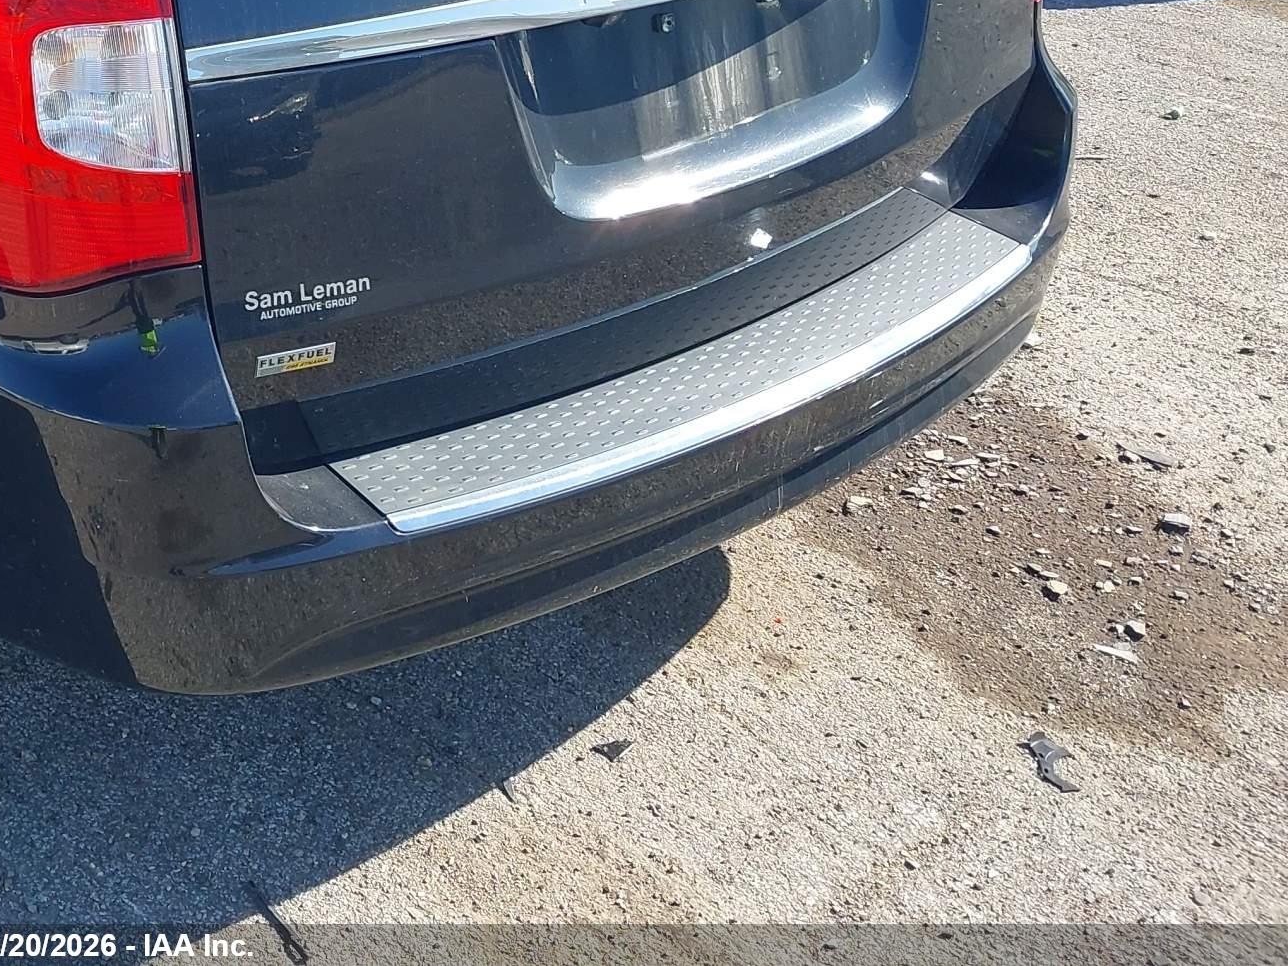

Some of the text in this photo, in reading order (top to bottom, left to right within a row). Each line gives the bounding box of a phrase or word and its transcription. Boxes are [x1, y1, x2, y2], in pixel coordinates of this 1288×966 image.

[244, 276, 371, 311] Sam Leman
[260, 295, 358, 321] AUTOMOTIVE GROUP
[260, 347, 332, 369] FLEXFUEL
